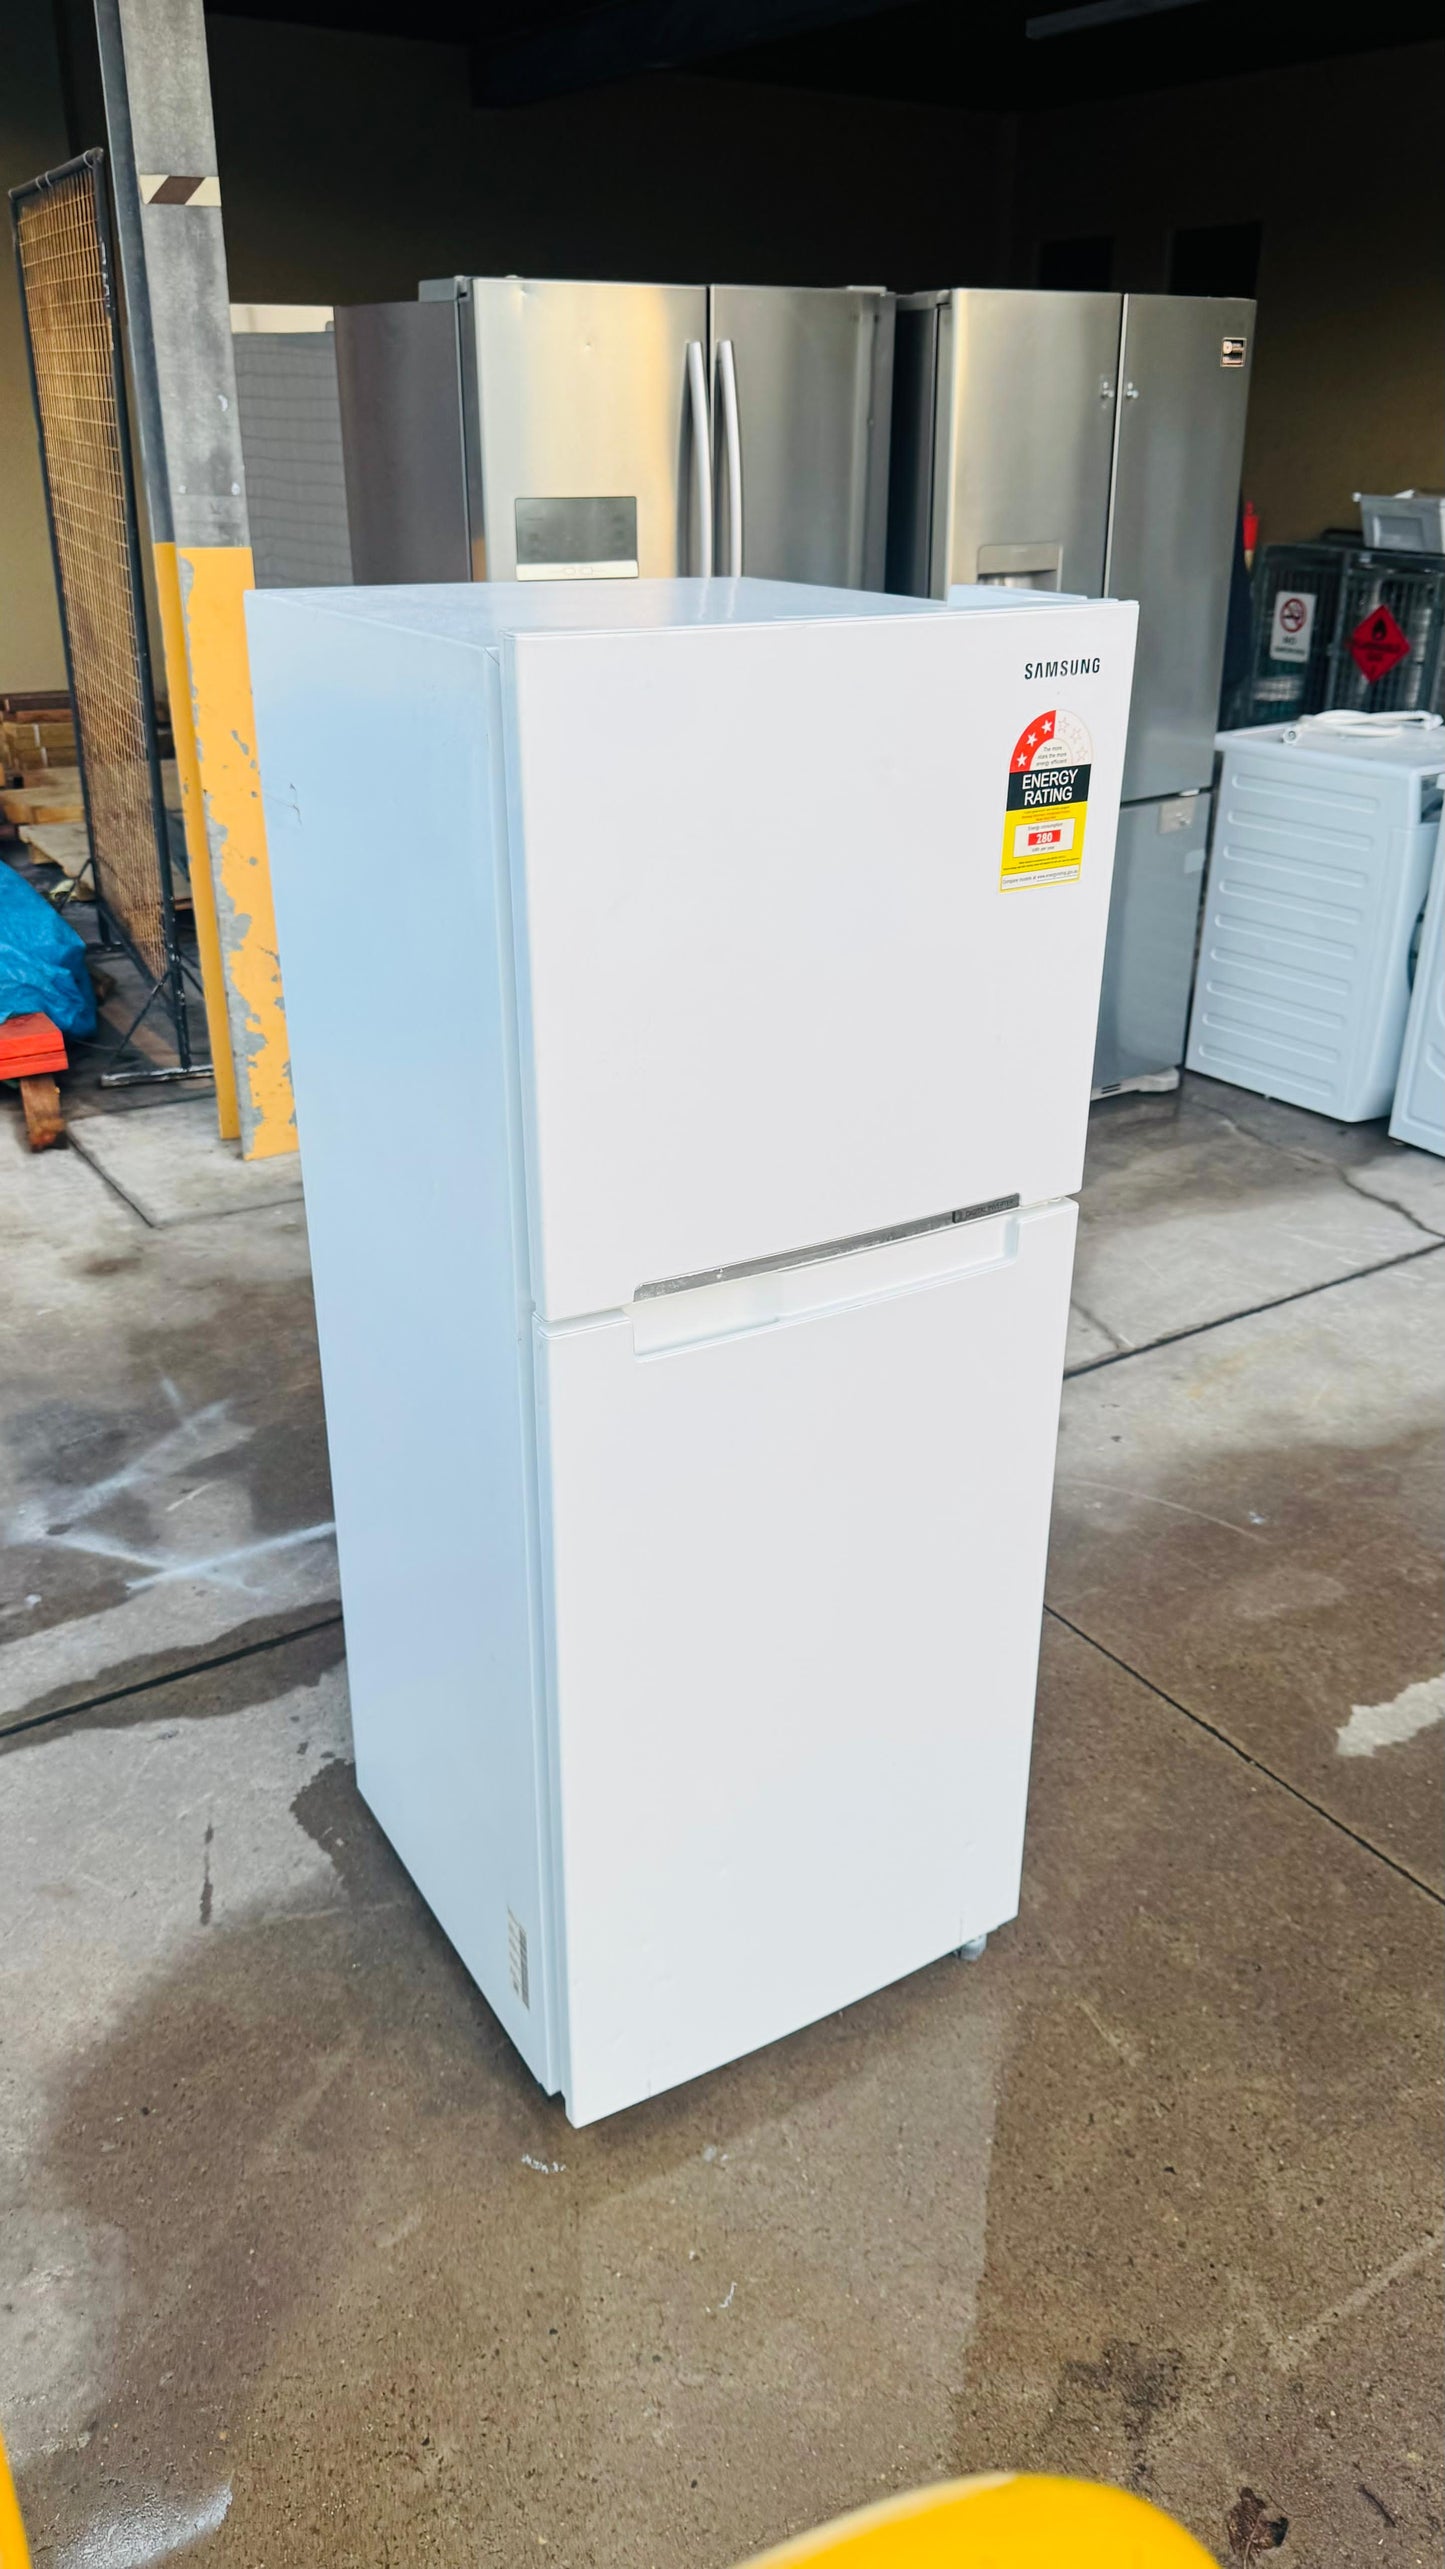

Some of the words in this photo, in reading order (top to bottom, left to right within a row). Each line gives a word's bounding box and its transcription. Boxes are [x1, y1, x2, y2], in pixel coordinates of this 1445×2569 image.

[1024, 657, 1101, 680] SAMSUNG
[1022, 768, 1078, 790] ENERGY
[1024, 786, 1073, 806] RATING
[1036, 832, 1053, 844] 280
